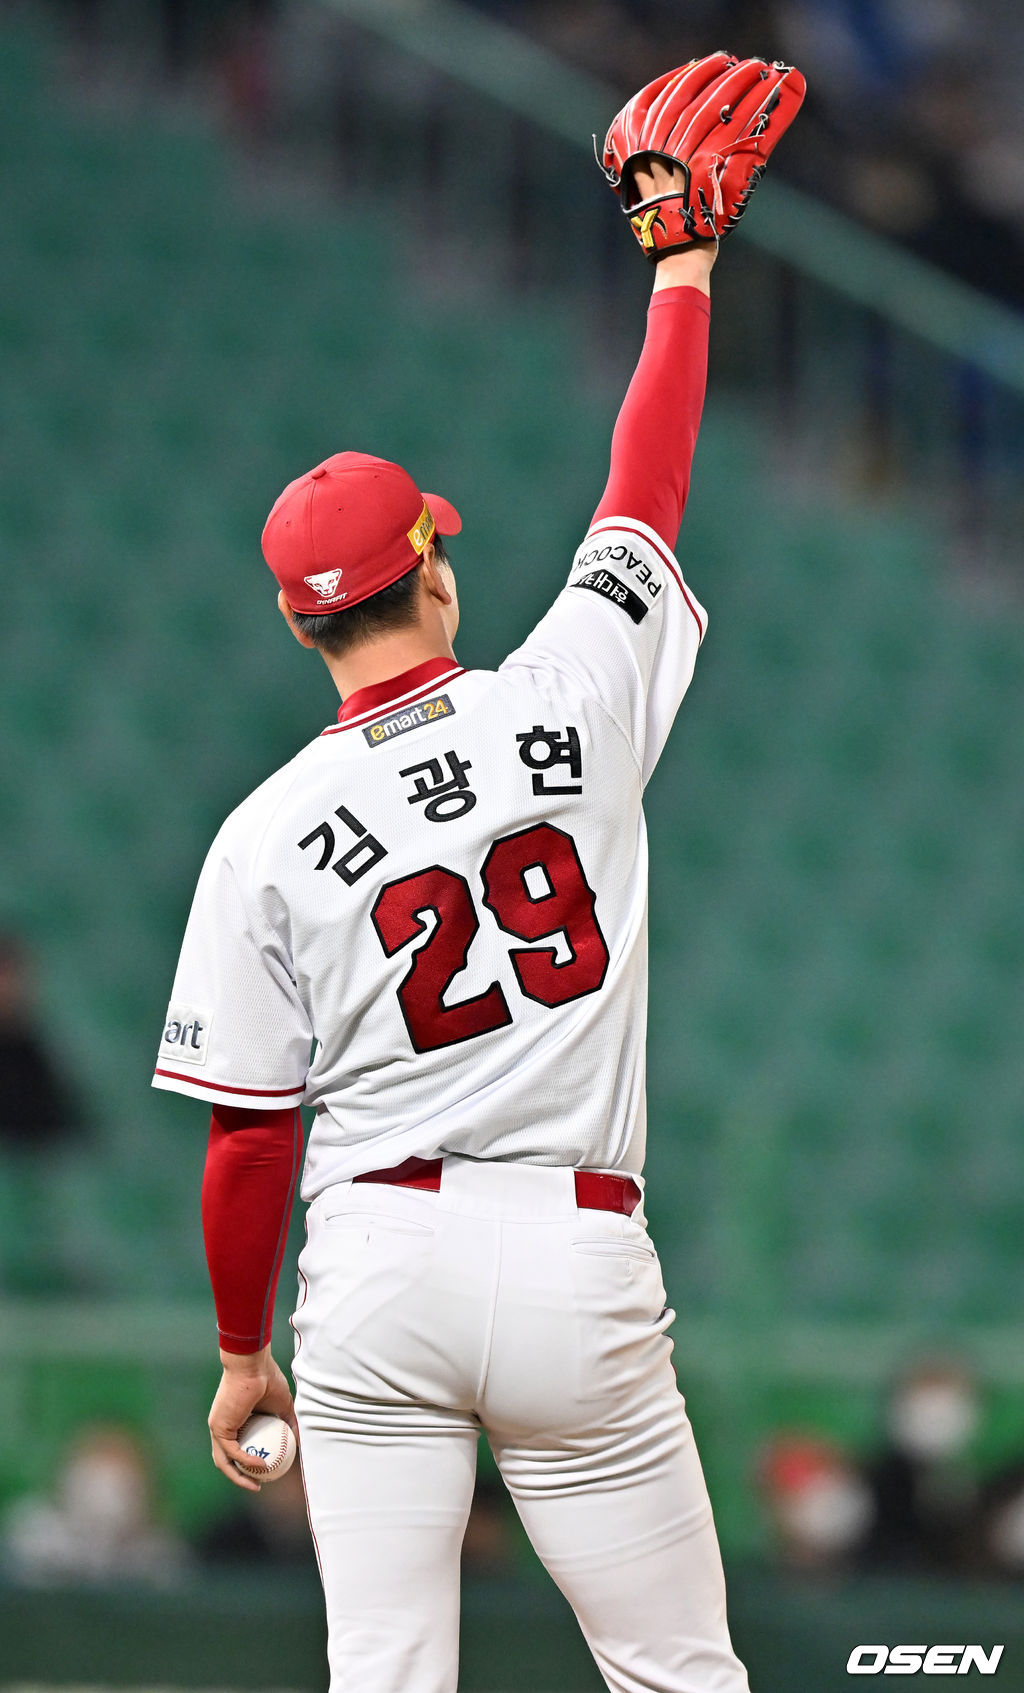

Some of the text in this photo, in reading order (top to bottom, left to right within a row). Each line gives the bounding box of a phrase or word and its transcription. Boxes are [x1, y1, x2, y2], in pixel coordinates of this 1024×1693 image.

[576, 545, 661, 598] PEACOCK
[317, 592, 348, 605] DYNAFIT
[370, 699, 448, 740] emart24
[370, 821, 610, 1054] 29
